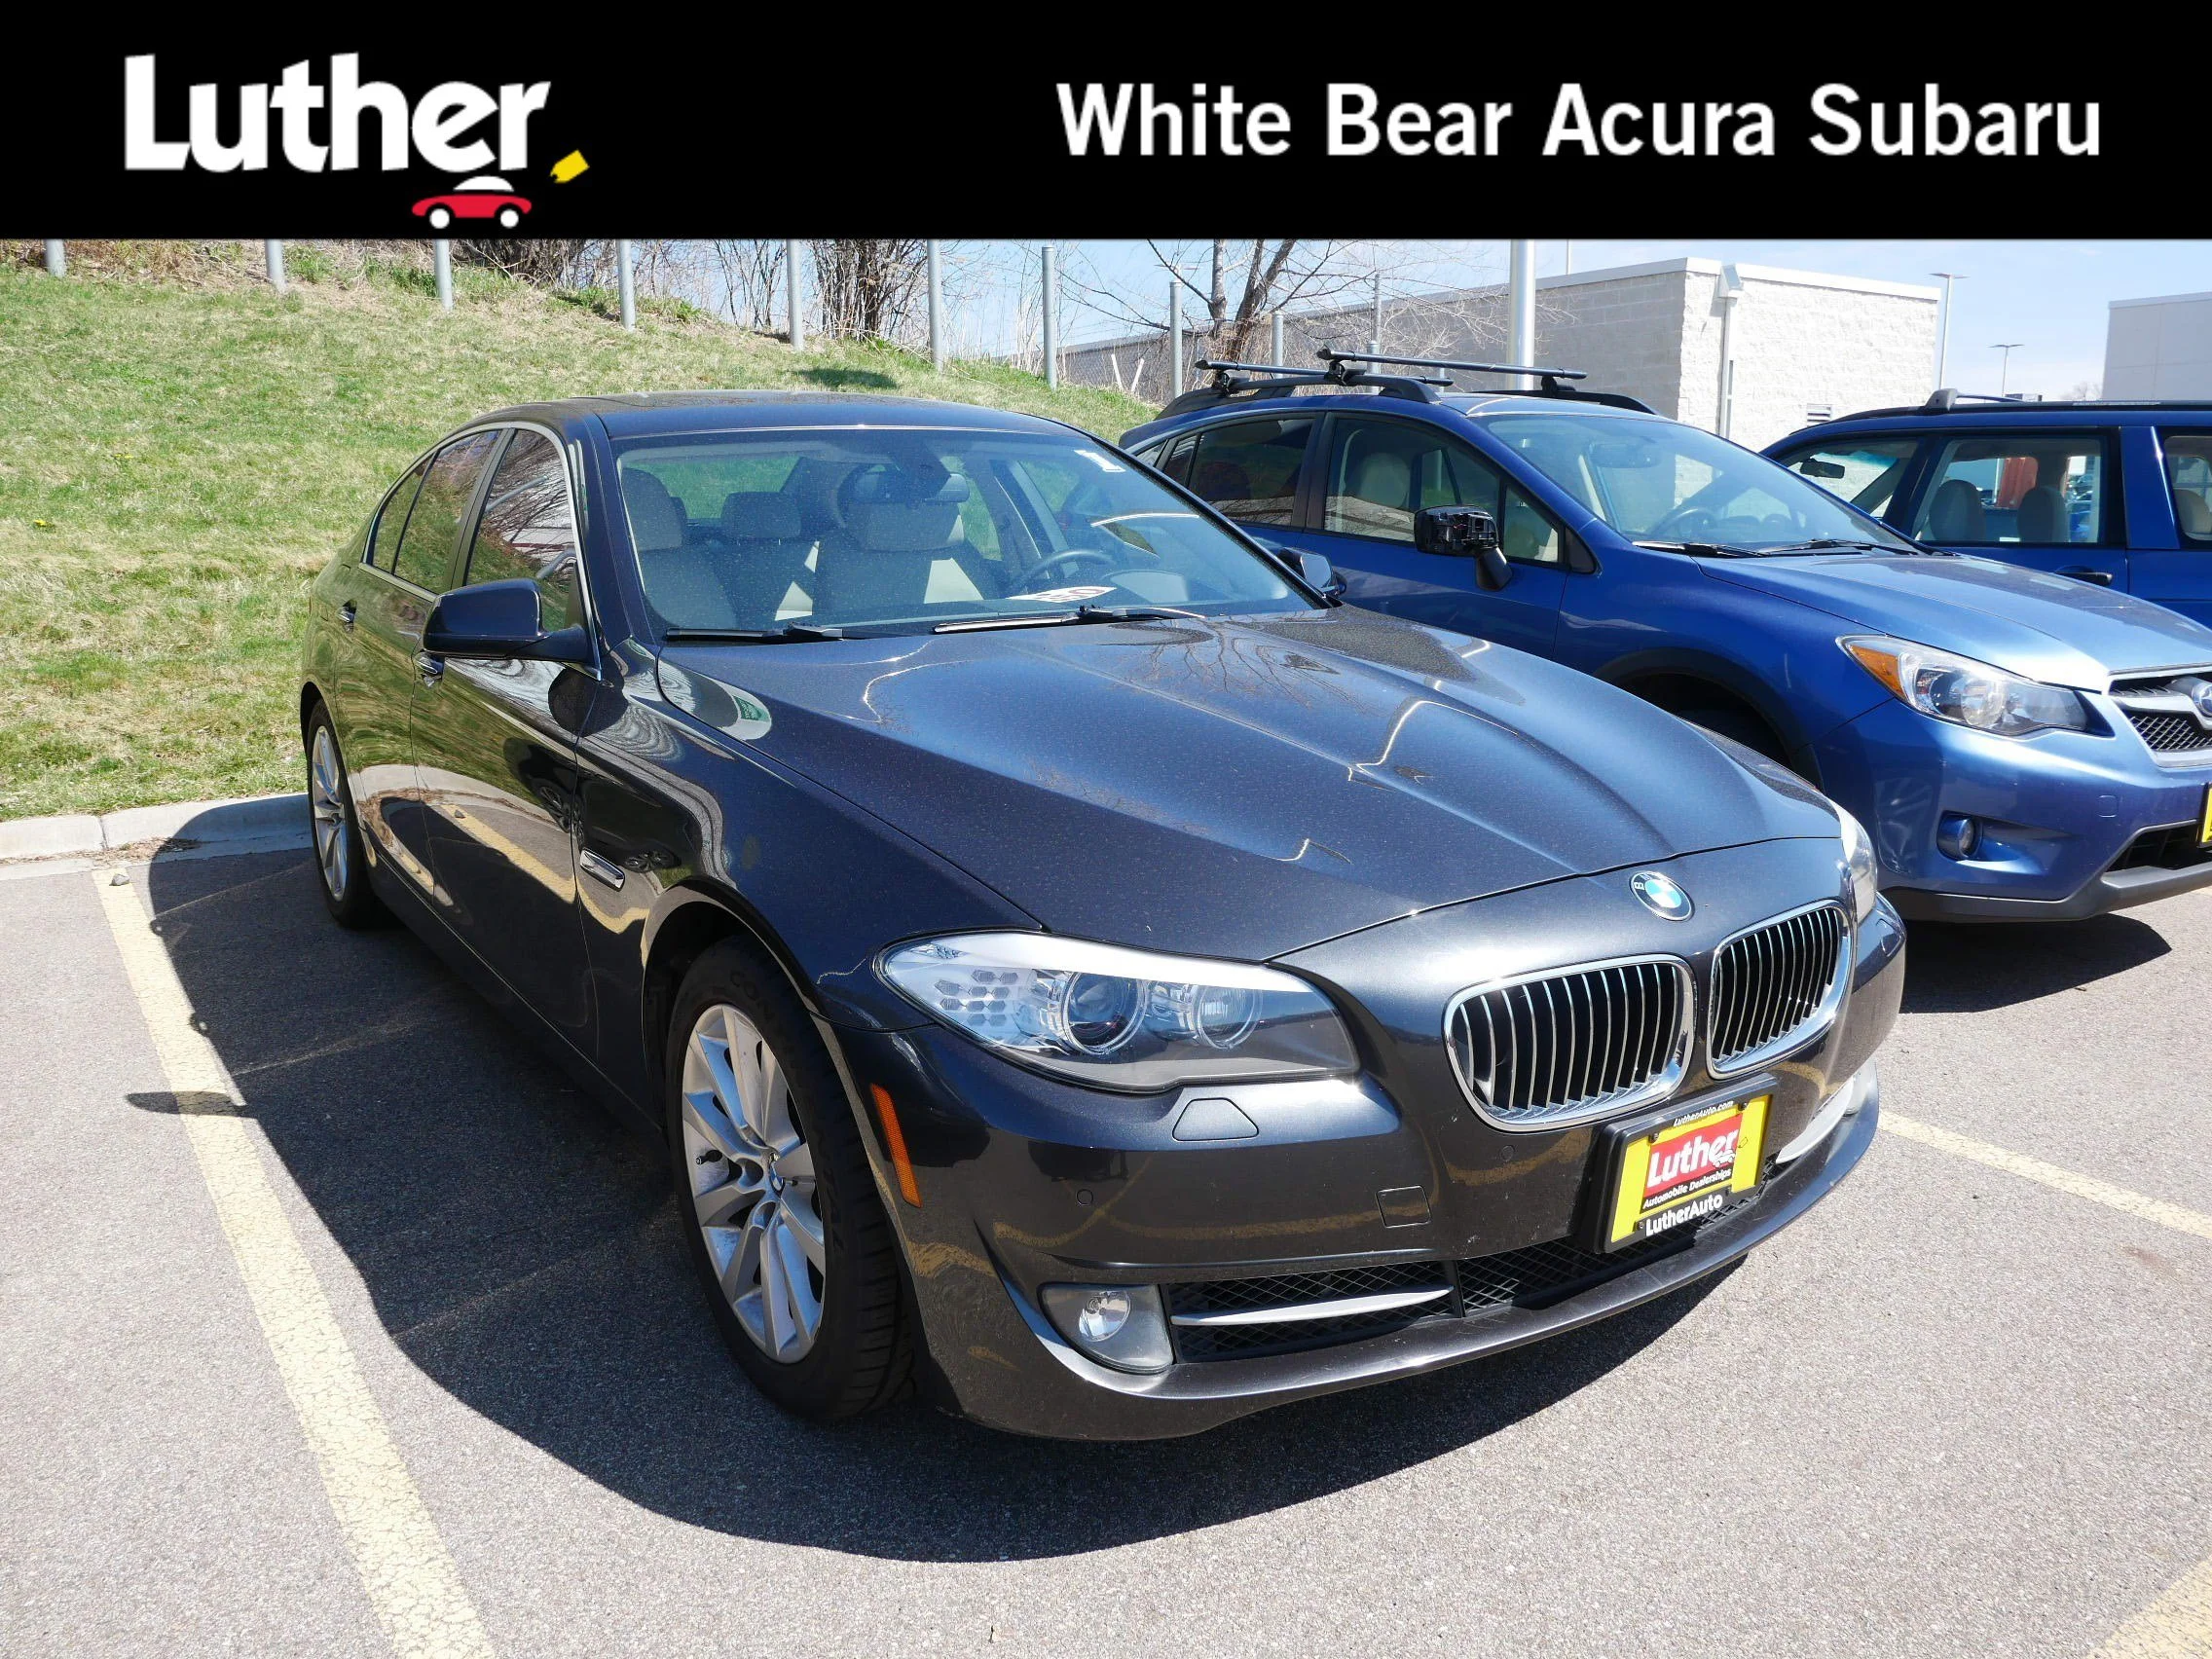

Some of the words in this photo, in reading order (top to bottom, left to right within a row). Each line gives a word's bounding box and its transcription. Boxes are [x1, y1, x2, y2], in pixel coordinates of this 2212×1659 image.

[1674, 1101, 1734, 1127] LutherAuto.com
[1647, 1128, 1739, 1188] Luther
[1642, 1185, 1689, 1209] Automobile
[1689, 1167, 1732, 1191] Dealerships
[1645, 1194, 1723, 1236] LutherAuto
